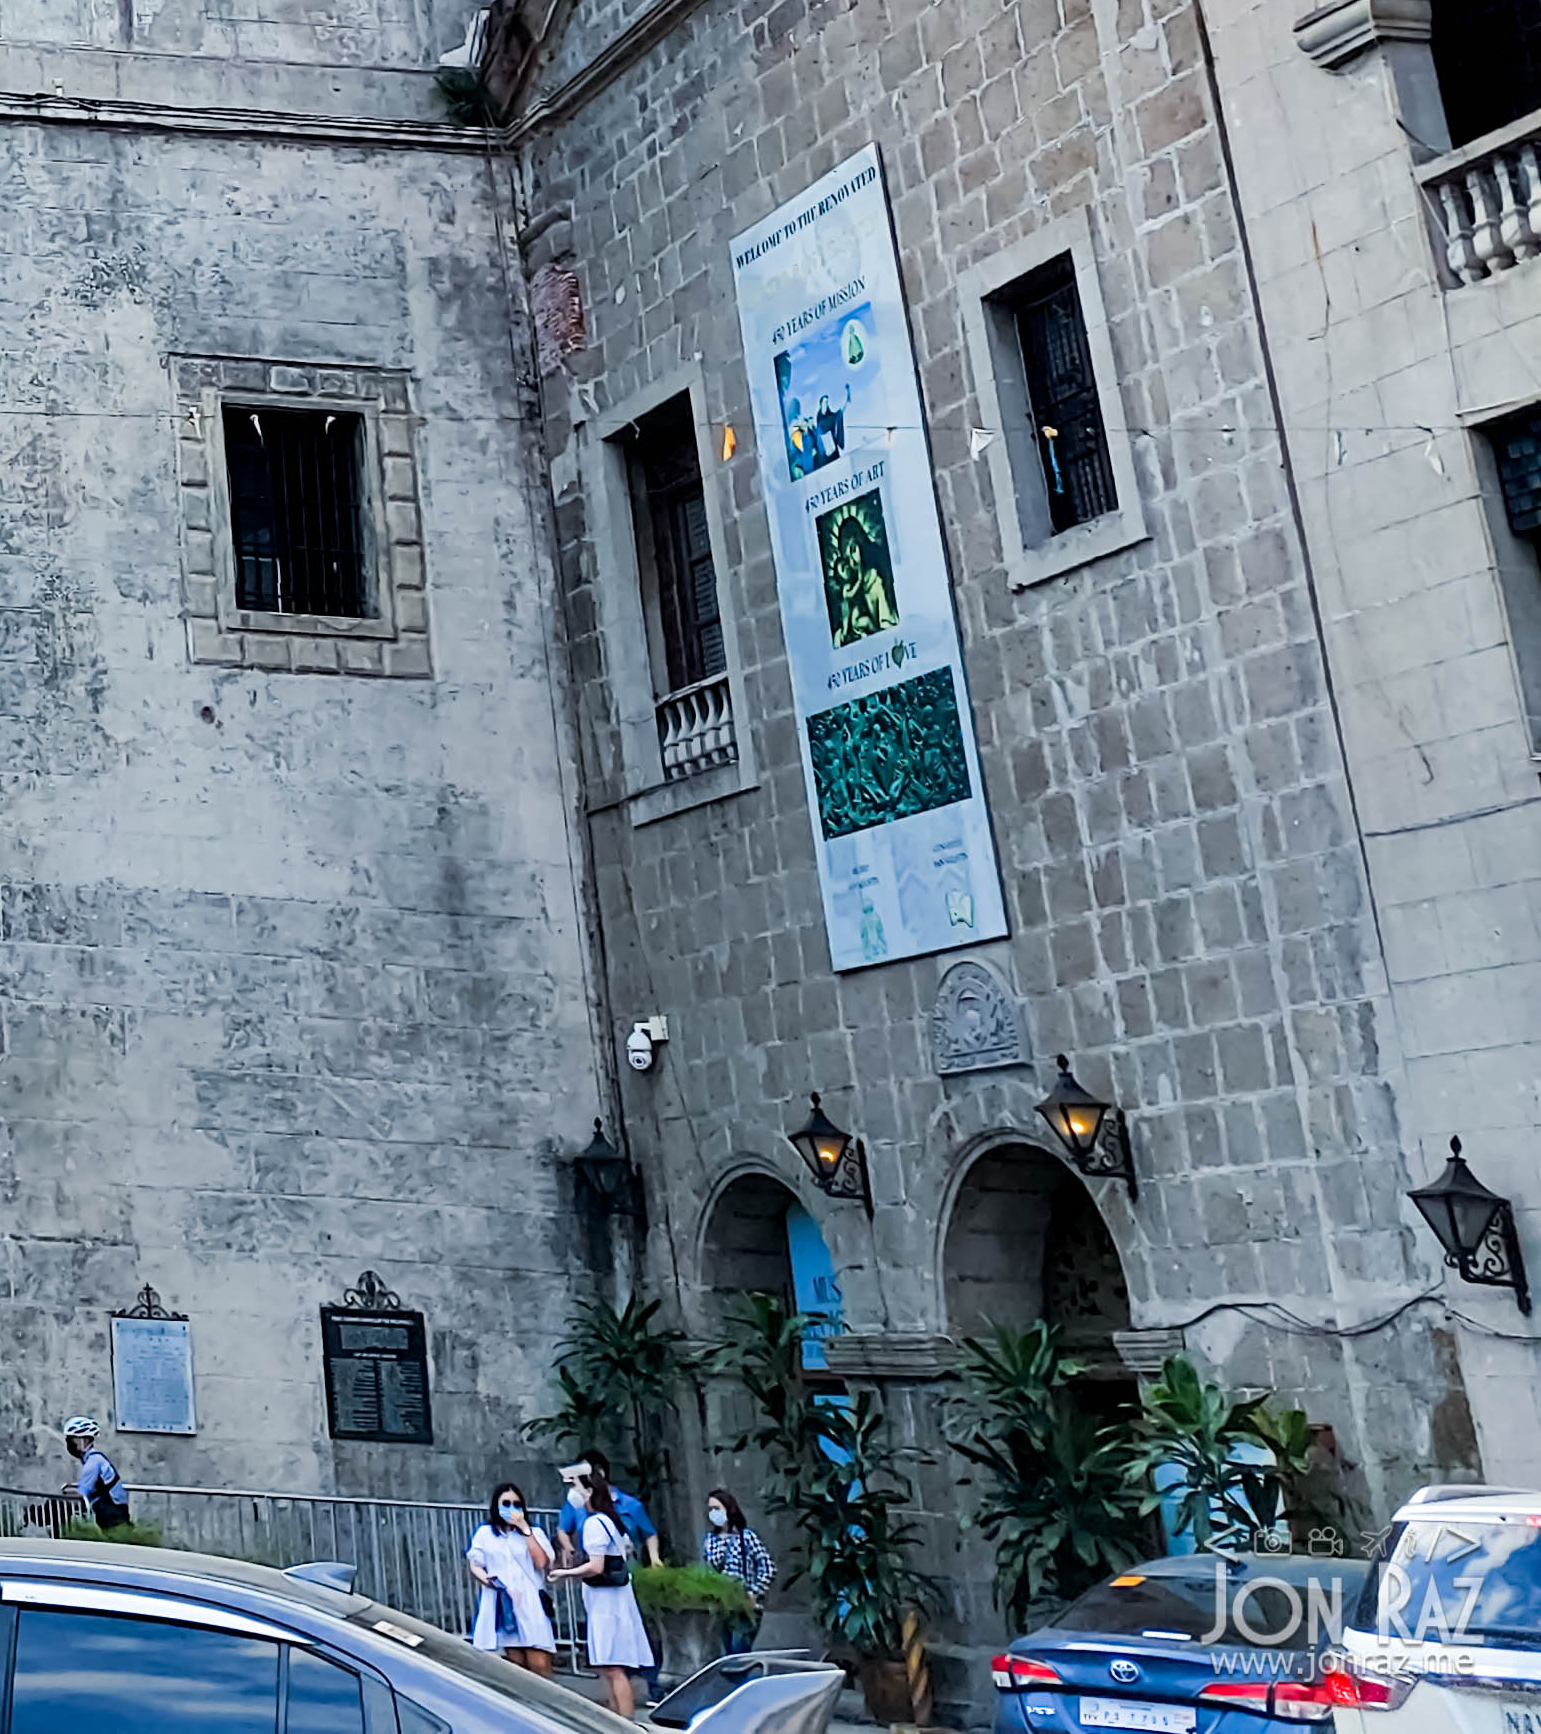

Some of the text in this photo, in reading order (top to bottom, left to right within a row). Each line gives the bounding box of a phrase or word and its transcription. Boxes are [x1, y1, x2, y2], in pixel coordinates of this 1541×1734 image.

[737, 229, 782, 269] WELCOME
[784, 220, 797, 240] TO
[797, 205, 817, 230] THE
[818, 165, 876, 216] RENOVATED
[786, 307, 814, 336] YEARS
[815, 299, 826, 320] OF
[827, 274, 865, 312] MISSION
[820, 478, 849, 505] YEARS
[851, 470, 863, 490] OF
[866, 460, 884, 482] ART
[842, 659, 870, 684] YEARS
[871, 654, 883, 674] OF
